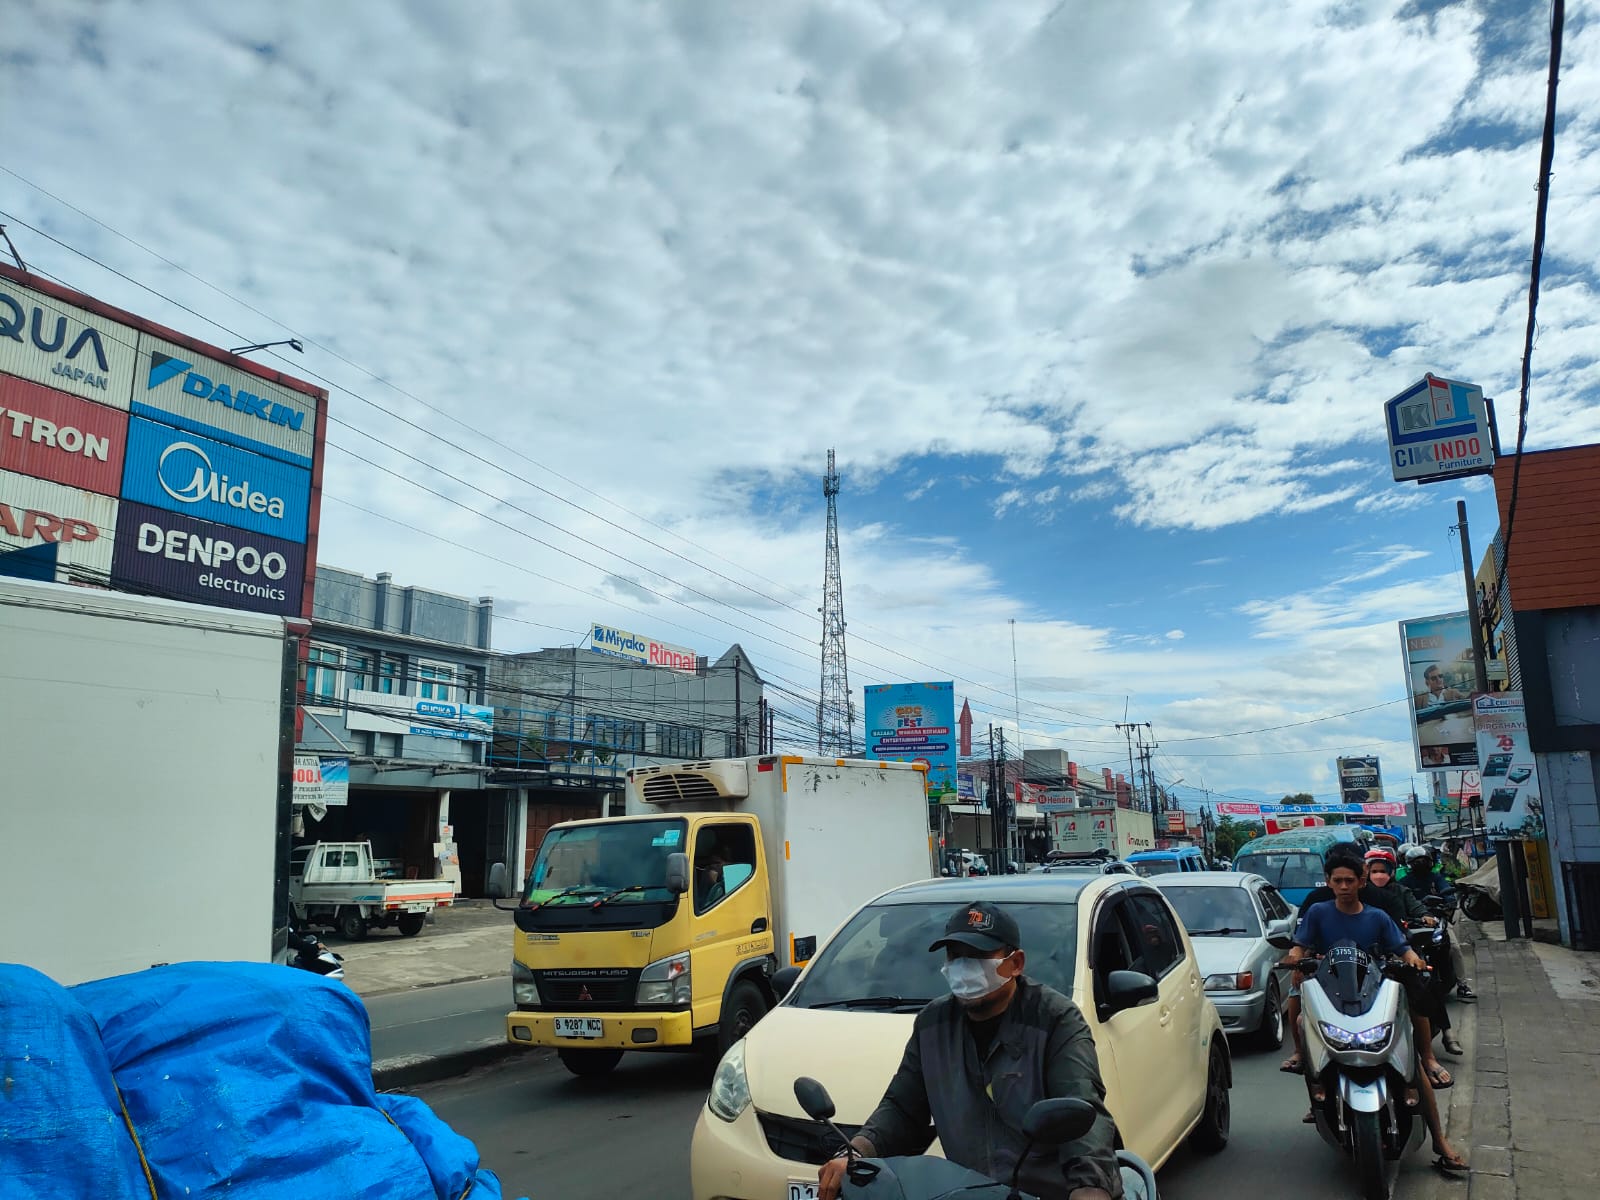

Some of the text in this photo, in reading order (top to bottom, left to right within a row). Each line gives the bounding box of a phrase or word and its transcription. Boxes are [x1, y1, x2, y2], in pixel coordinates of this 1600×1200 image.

[52, 361, 108, 391] JAPAN
[182, 370, 305, 432] DAIKIN
[0, 407, 109, 462] TRON
[1394, 438, 1480, 468] CIKINDO
[1439, 457, 1483, 470] Furniture
[176, 467, 286, 520] Midea
[137, 522, 287, 581] DENPOO
[199, 573, 286, 601] electronics
[605, 629, 646, 653] Miyako
[1410, 638, 1439, 650] NEW
[649, 642, 695, 672] Rinnai
[897, 717, 923, 727] FEST
[1047, 795, 1073, 804] Hendra
[1336, 948, 1352, 956] 3755
[555, 1019, 561, 1030] B
